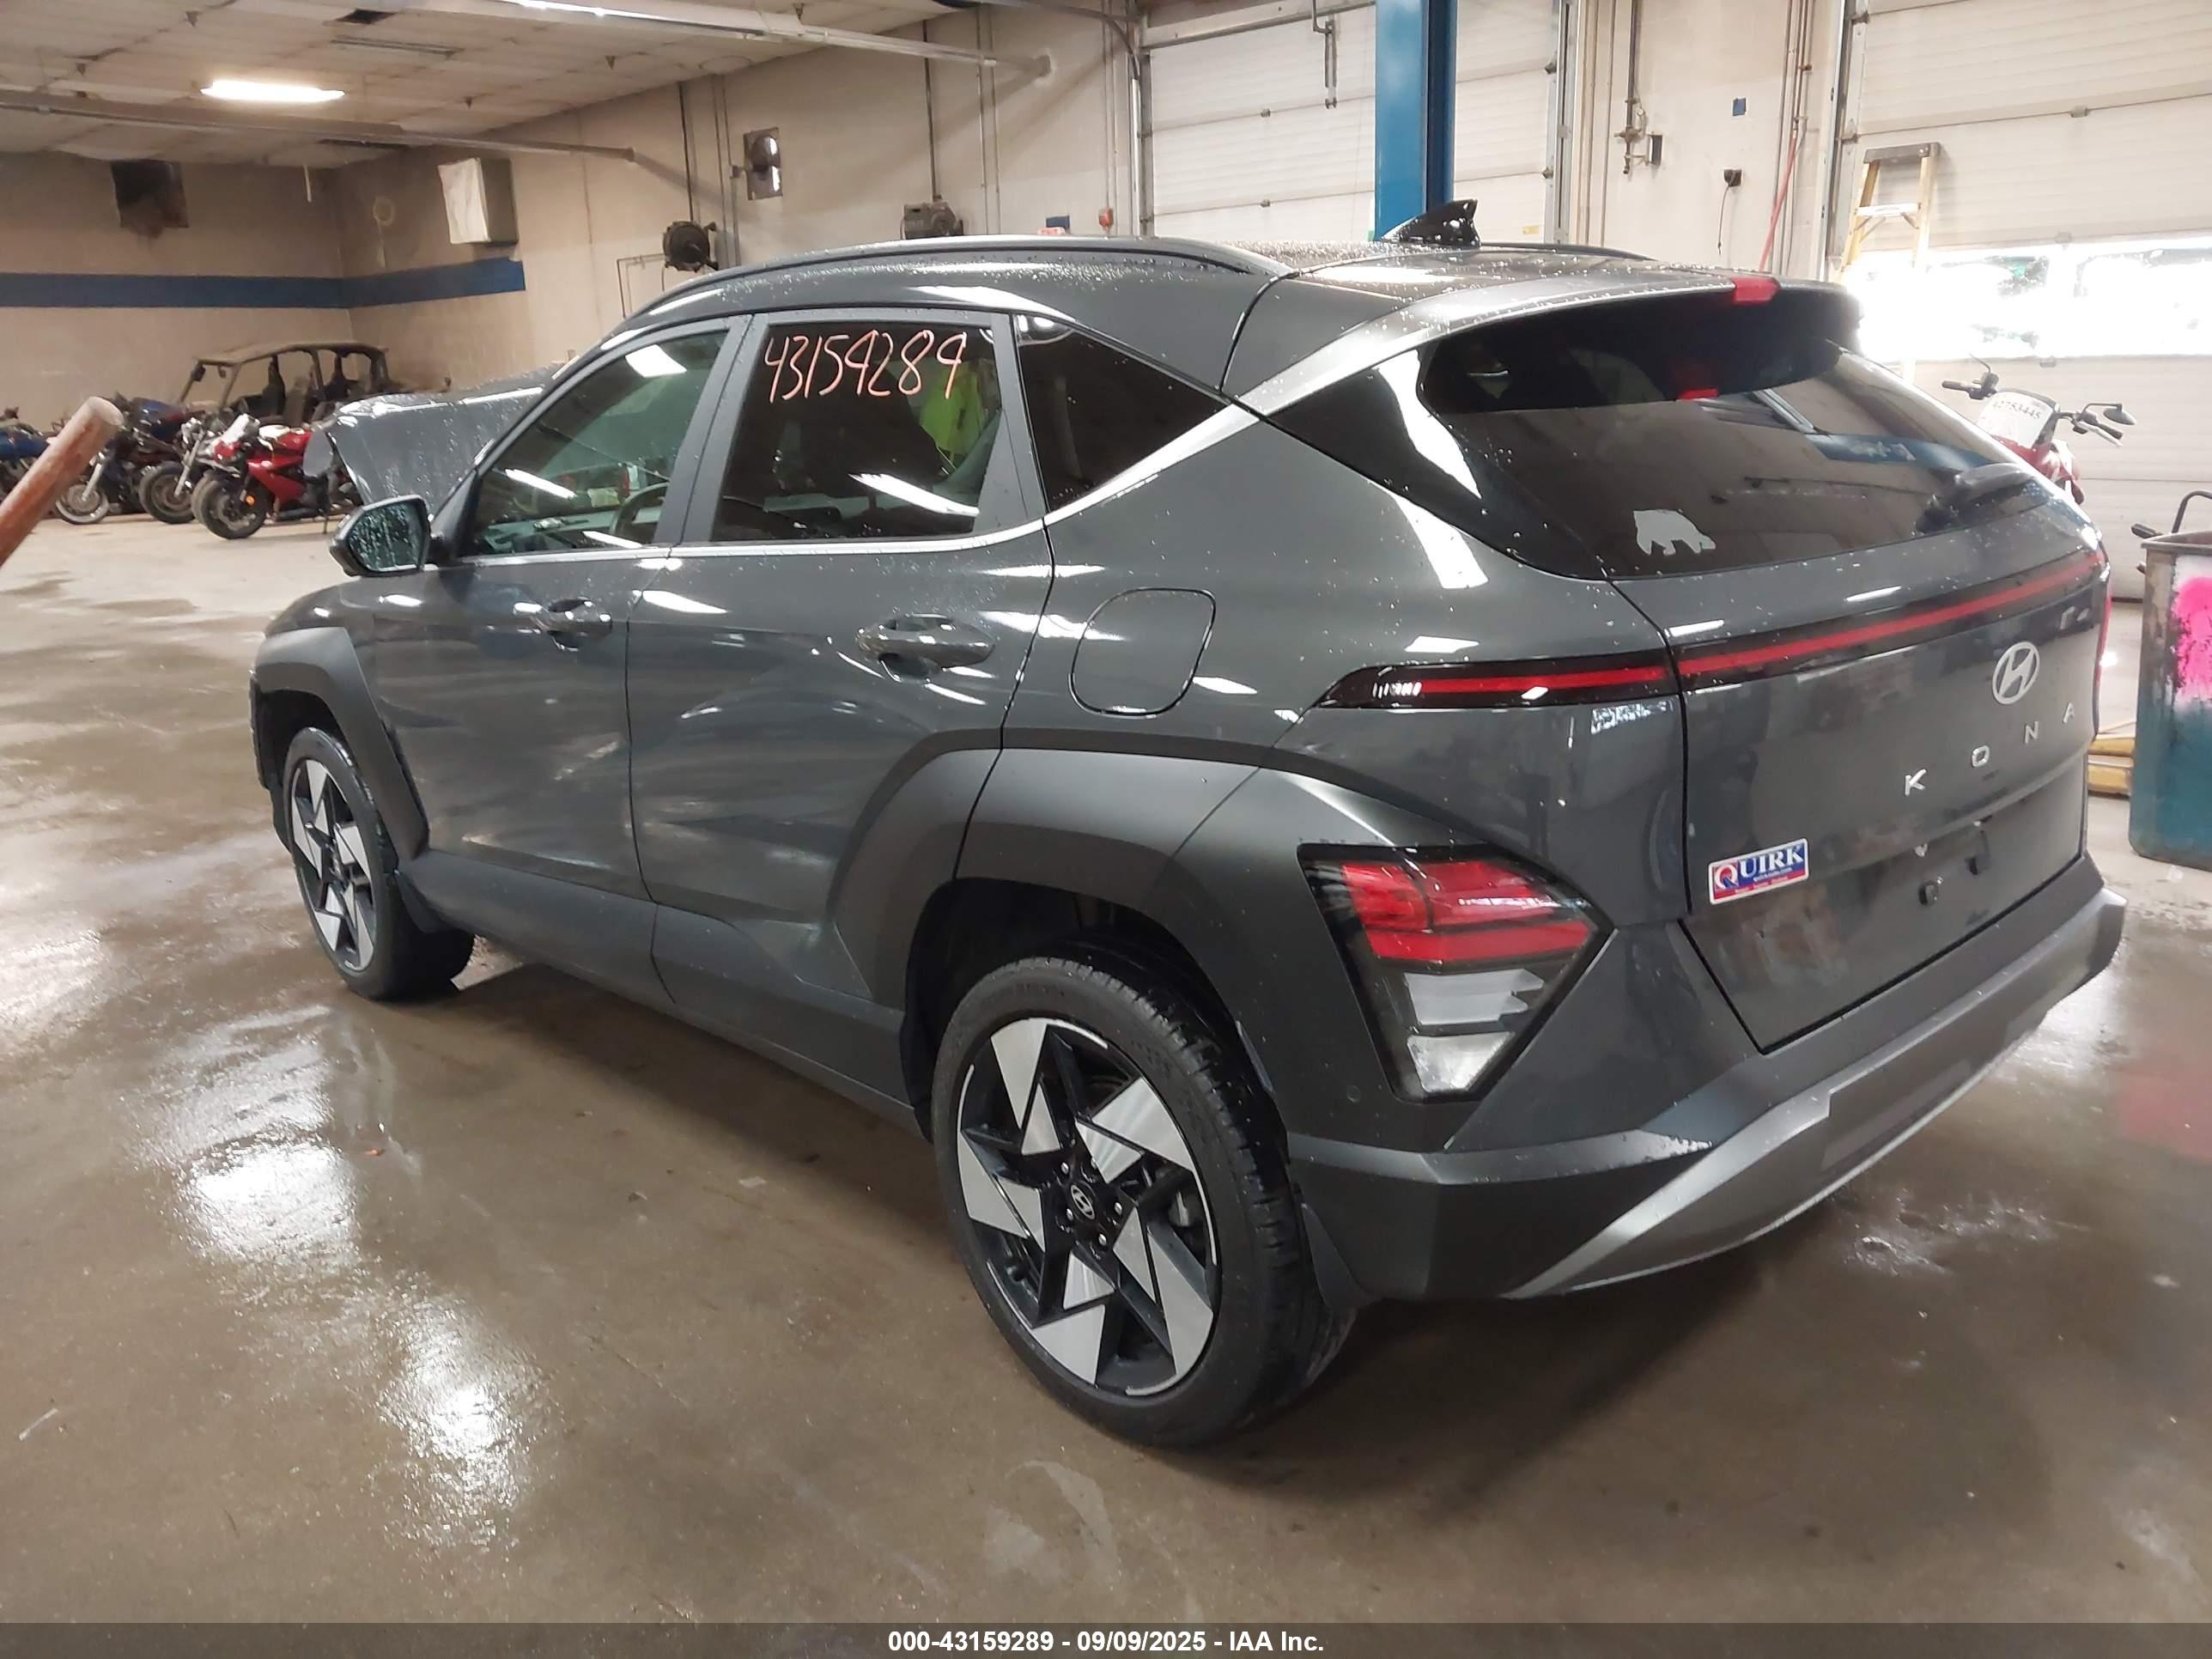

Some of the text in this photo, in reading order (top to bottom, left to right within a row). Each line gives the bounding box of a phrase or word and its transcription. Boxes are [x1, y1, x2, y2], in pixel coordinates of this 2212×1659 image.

[764, 329, 967, 404] 43159289
[1904, 702, 2075, 796] KONA
[1714, 844, 1803, 890] QUIRK
